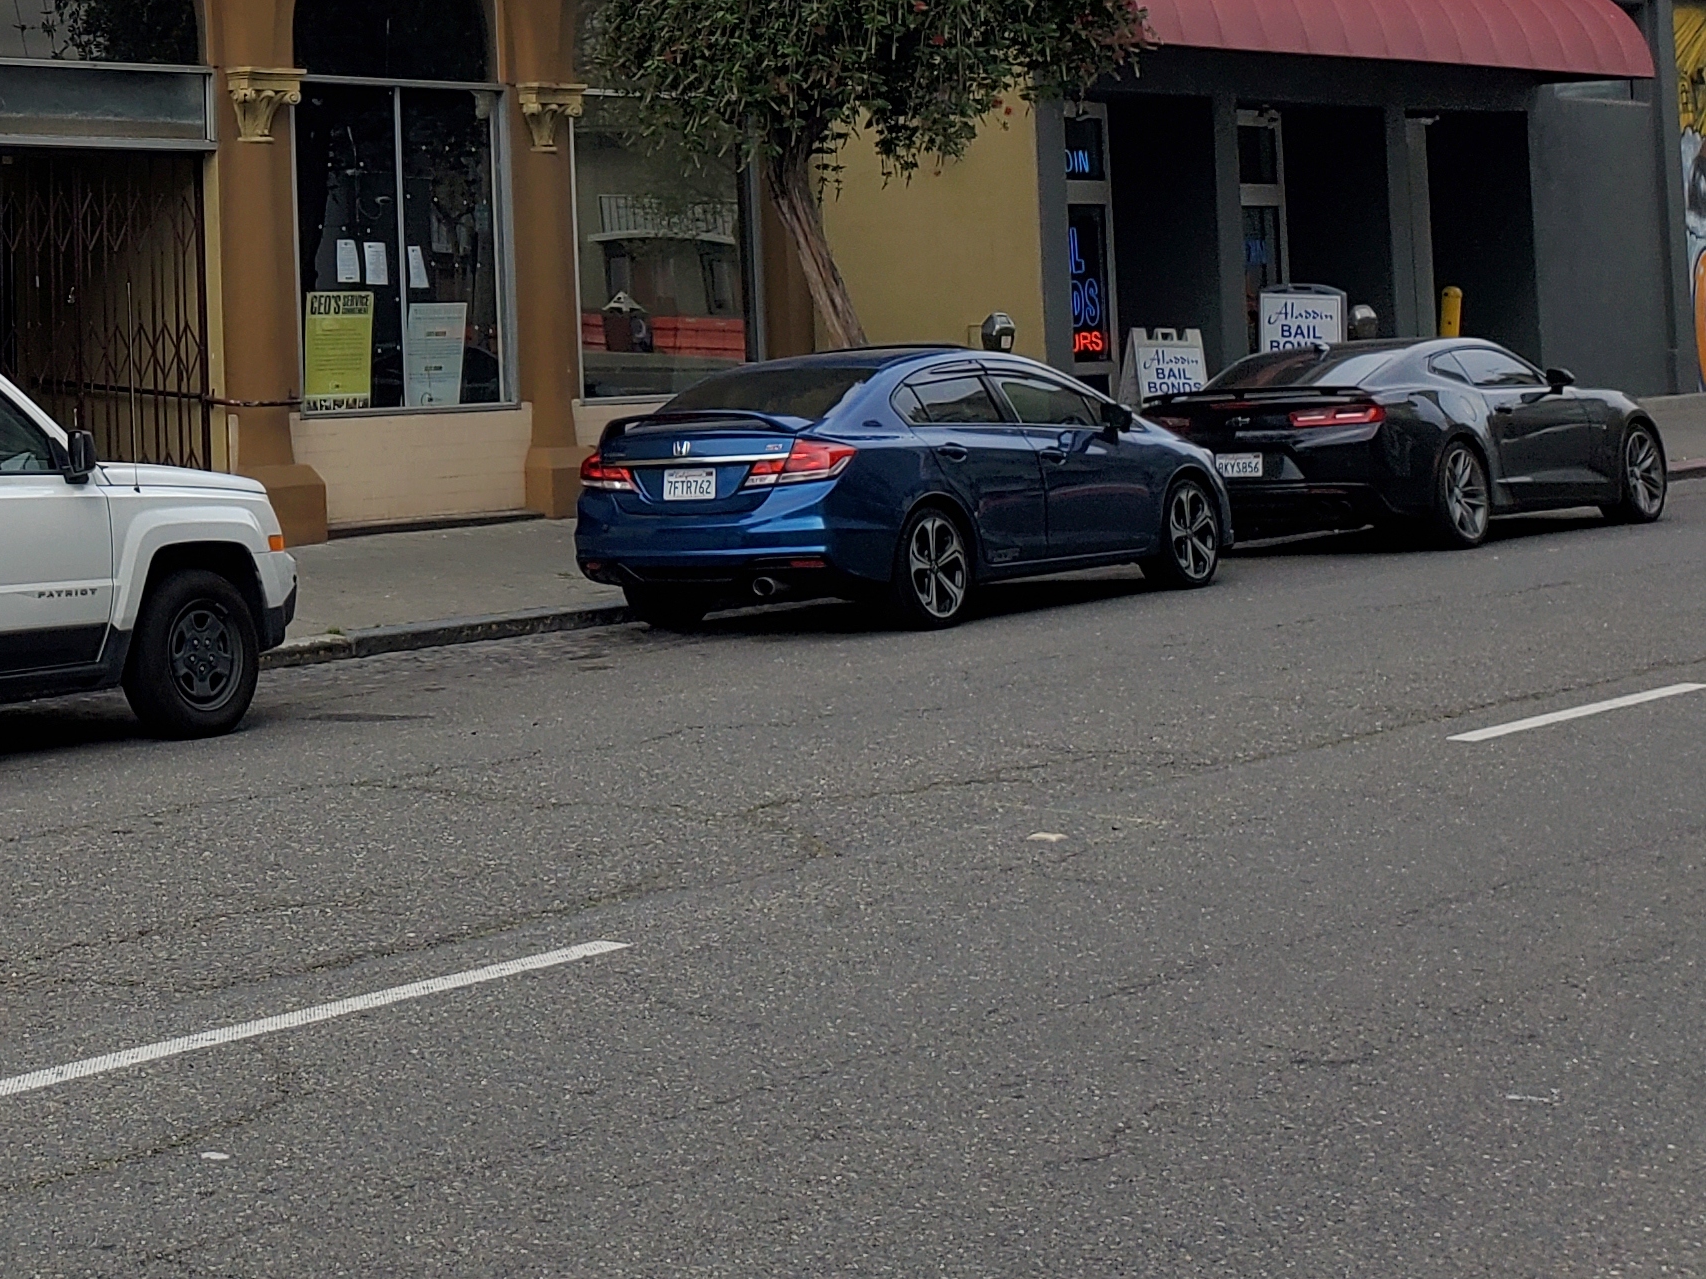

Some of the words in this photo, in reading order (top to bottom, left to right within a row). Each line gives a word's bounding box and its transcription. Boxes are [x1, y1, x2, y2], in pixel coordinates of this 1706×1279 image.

[1267, 301, 1333, 325] Aladdin
[1280, 324, 1323, 339] BAIL
[1143, 349, 1198, 369] Aladdin
[1155, 367, 1192, 380] BAIL
[667, 480, 712, 496] 7FTR762
[37, 588, 98, 598] PATRIOT
